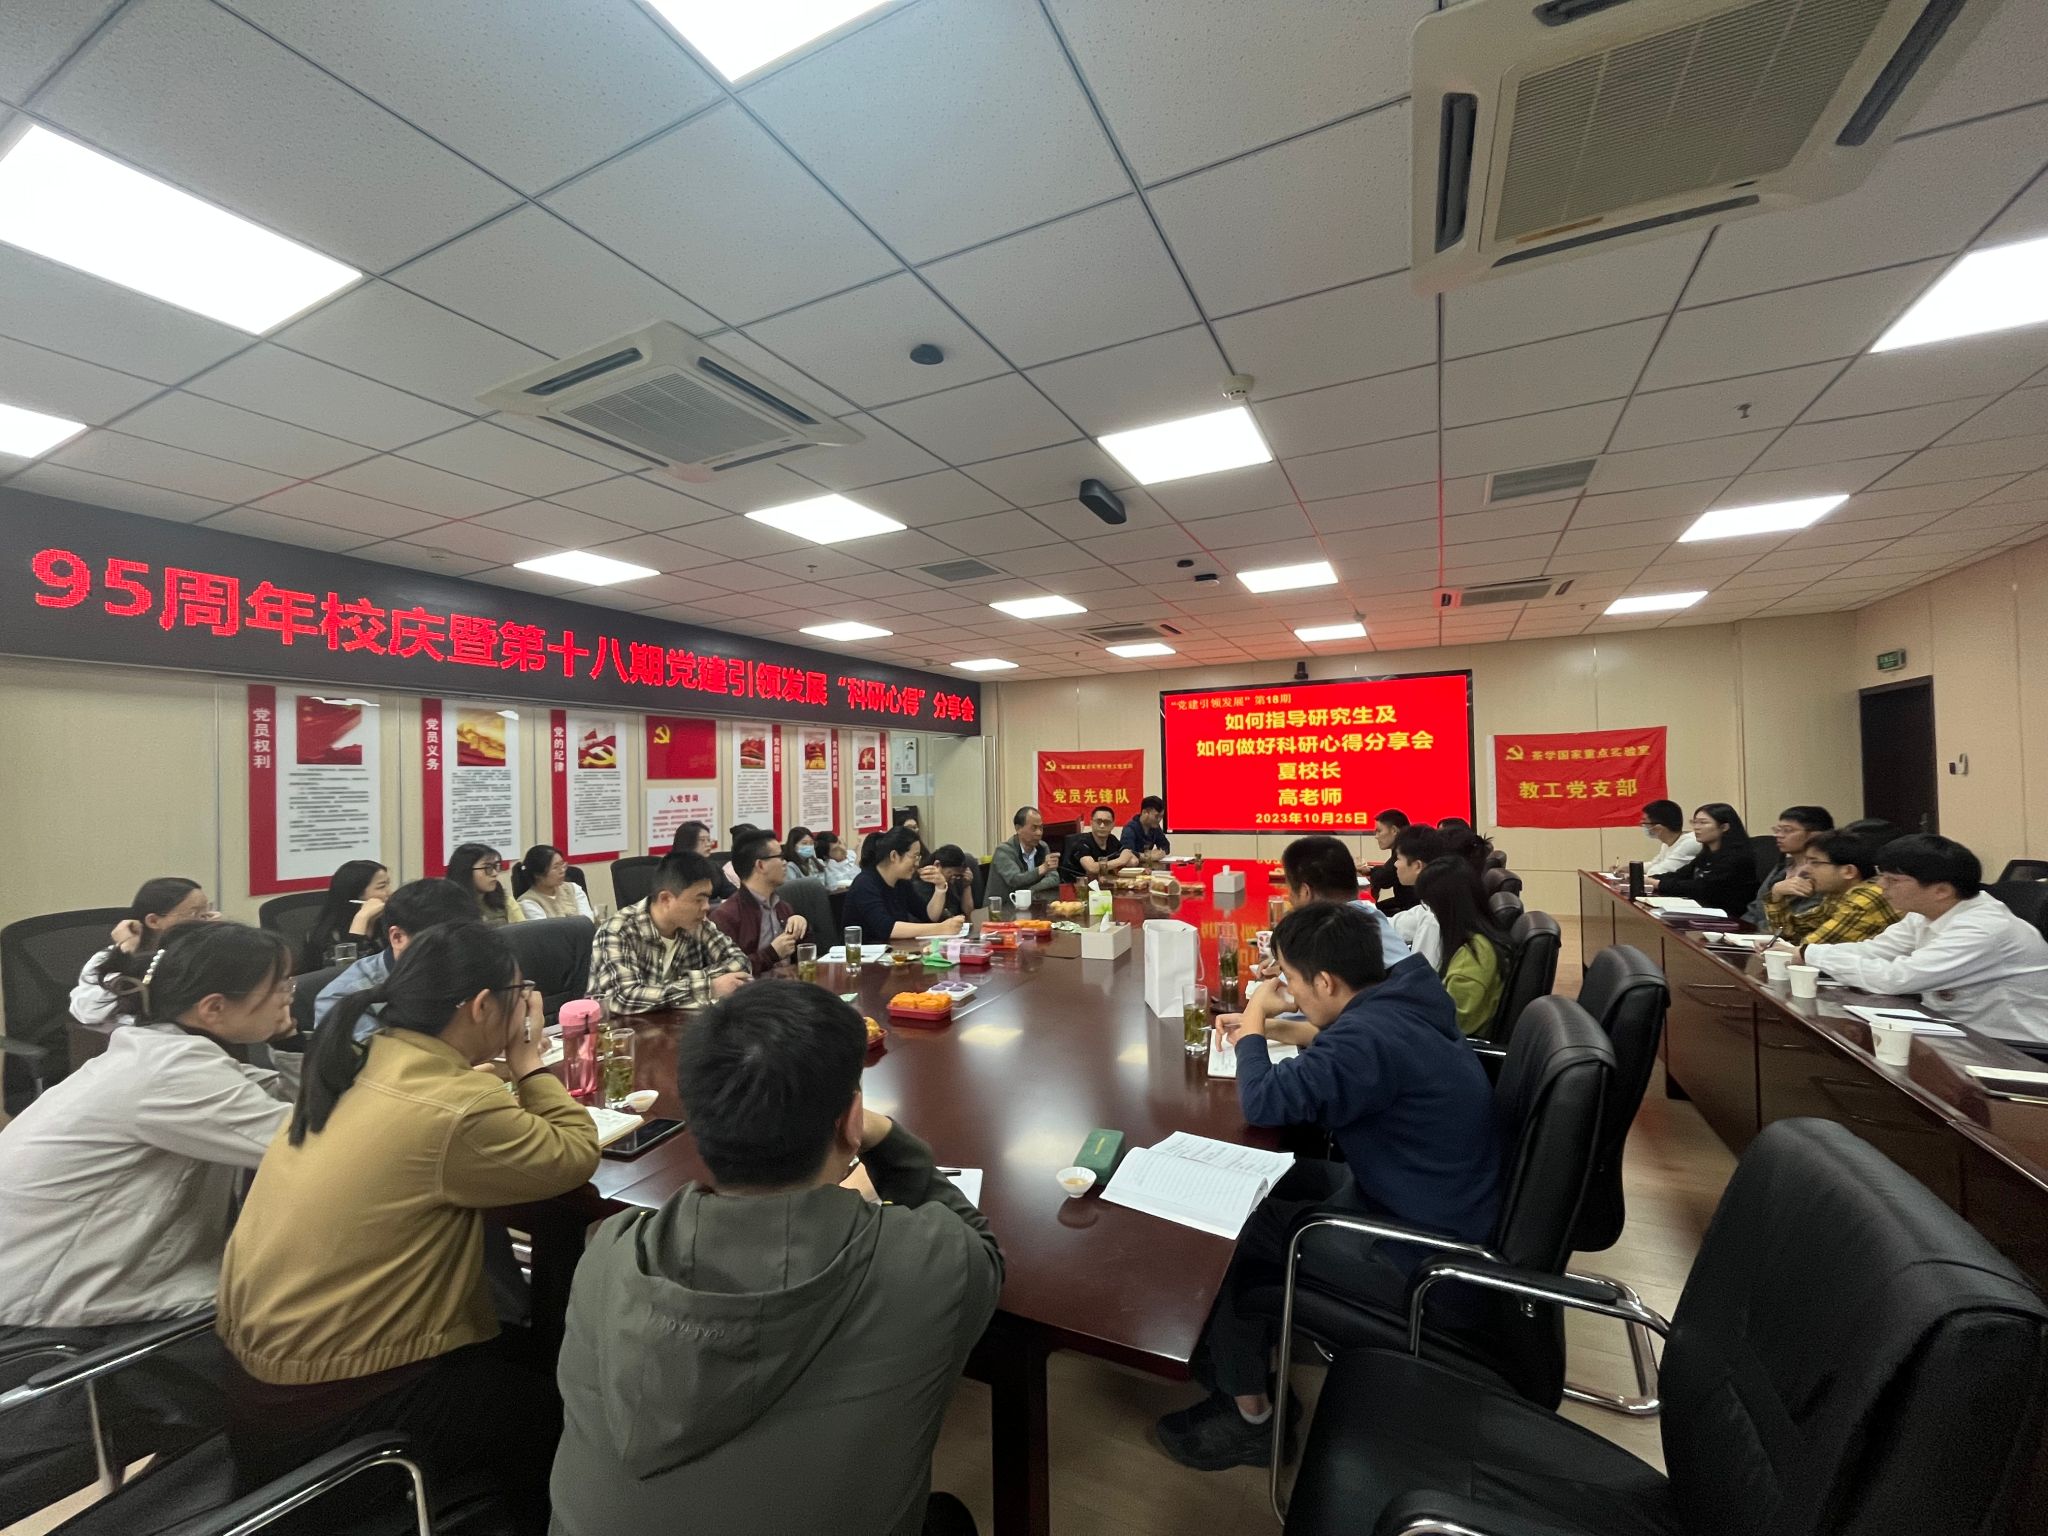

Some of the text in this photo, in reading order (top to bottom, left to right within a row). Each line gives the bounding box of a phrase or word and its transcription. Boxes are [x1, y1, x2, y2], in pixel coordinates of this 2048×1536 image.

[31, 547, 828, 707] 95周年校庆暨第十八期党建引领发展
[933, 691, 975, 722] 分享会
[1254, 693, 1292, 706] 第18期
[1224, 705, 1398, 731] 如何指导研究生及
[252, 707, 271, 769] 党员权利
[425, 717, 440, 771] 党员义务
[553, 726, 565, 772] 党的纪律
[1196, 730, 1434, 757] 如何做好科研心得分享会
[1277, 761, 1341, 781] 夏校长
[1052, 788, 1130, 804] 党员先锋队
[1278, 787, 1342, 807] 高老师
[1519, 778, 1638, 799] 教工党支部
[1256, 812, 1367, 825] 2023年10月25日
